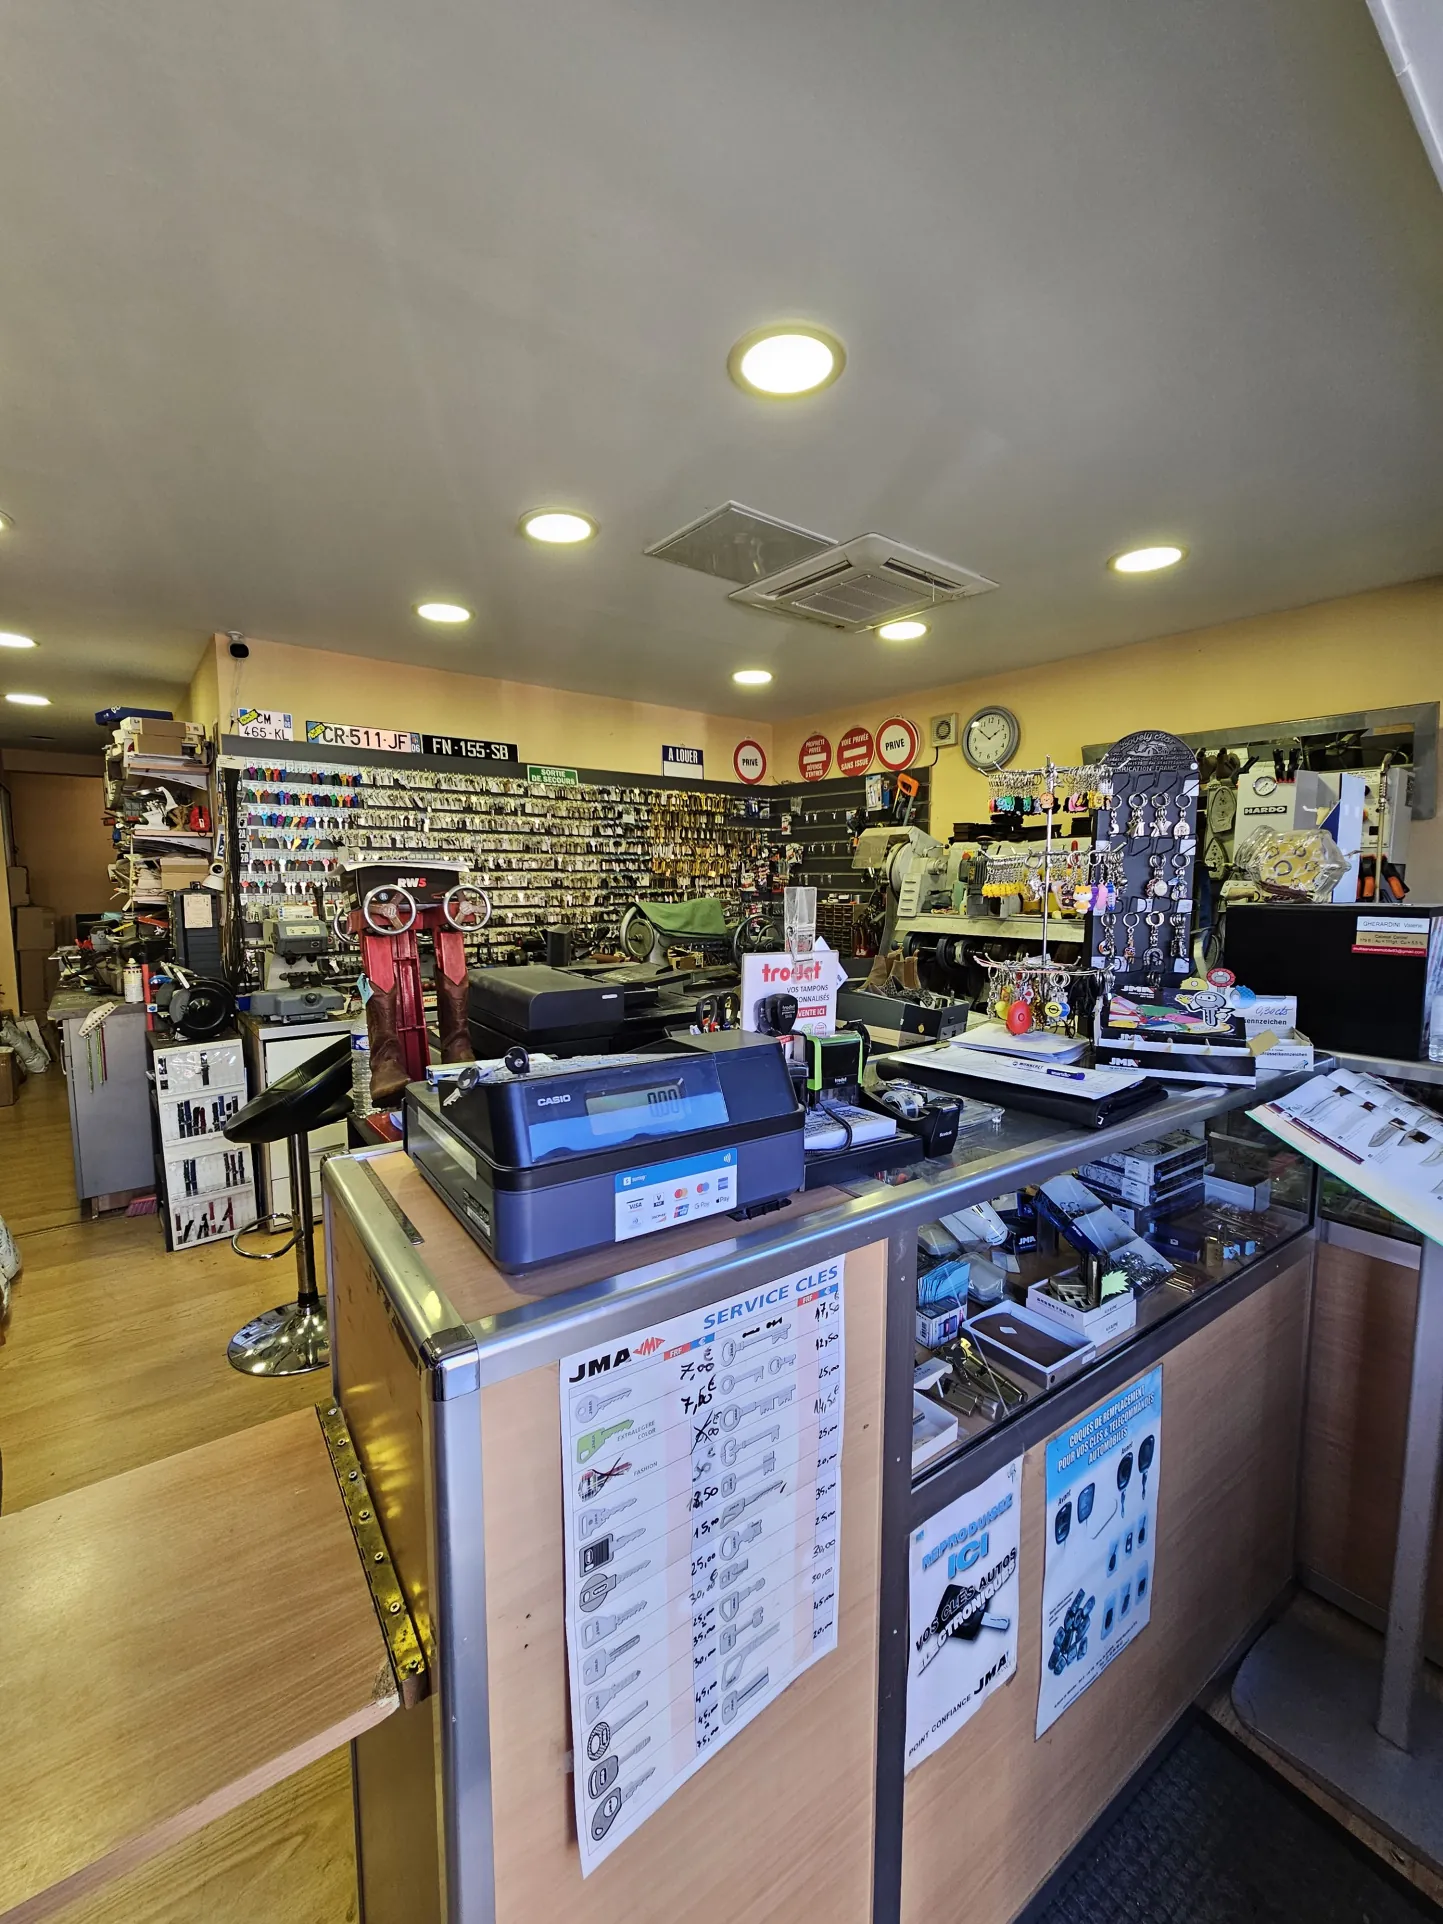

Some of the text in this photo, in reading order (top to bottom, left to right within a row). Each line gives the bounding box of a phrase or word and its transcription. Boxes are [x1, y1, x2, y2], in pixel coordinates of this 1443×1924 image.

[322, 726, 408, 750] CR-511-JF
[668, 747, 698, 764] A LOUER
[841, 758, 868, 770] SANS ISSUE
[540, 768, 566, 778] SORTIE
[542, 776, 576, 786] SECOURS
[397, 878, 426, 888] RW5
[1109, 1057, 1138, 1068] JMA
[537, 1094, 571, 1107] CASIO
[1019, 1236, 1036, 1245] JMA
[703, 1265, 838, 1330] SERVICE CLES
[569, 1348, 630, 1383] JMA
[680, 1362, 714, 1380] 7,00
[1069, 1384, 1145, 1448] COQUES DE REMPLACEMENT
[617, 1420, 655, 1441] EXTRALEGERE
[638, 1428, 656, 1440] COLOR
[1088, 1425, 1128, 1465] AUTOMOBILES
[1058, 1451, 1076, 1473] POUR
[1076, 1441, 1089, 1459] VOS
[634, 1461, 658, 1476] FASHION
[922, 1493, 1013, 1572] REPRODUISEZ
[691, 1553, 715, 1576] 25,00
[948, 1532, 989, 1579] ICI
[916, 1617, 939, 1651] VOS
[979, 1548, 1016, 1590] AUTOS
[909, 1655, 1006, 1757] POINT CONFIANCE JMA
